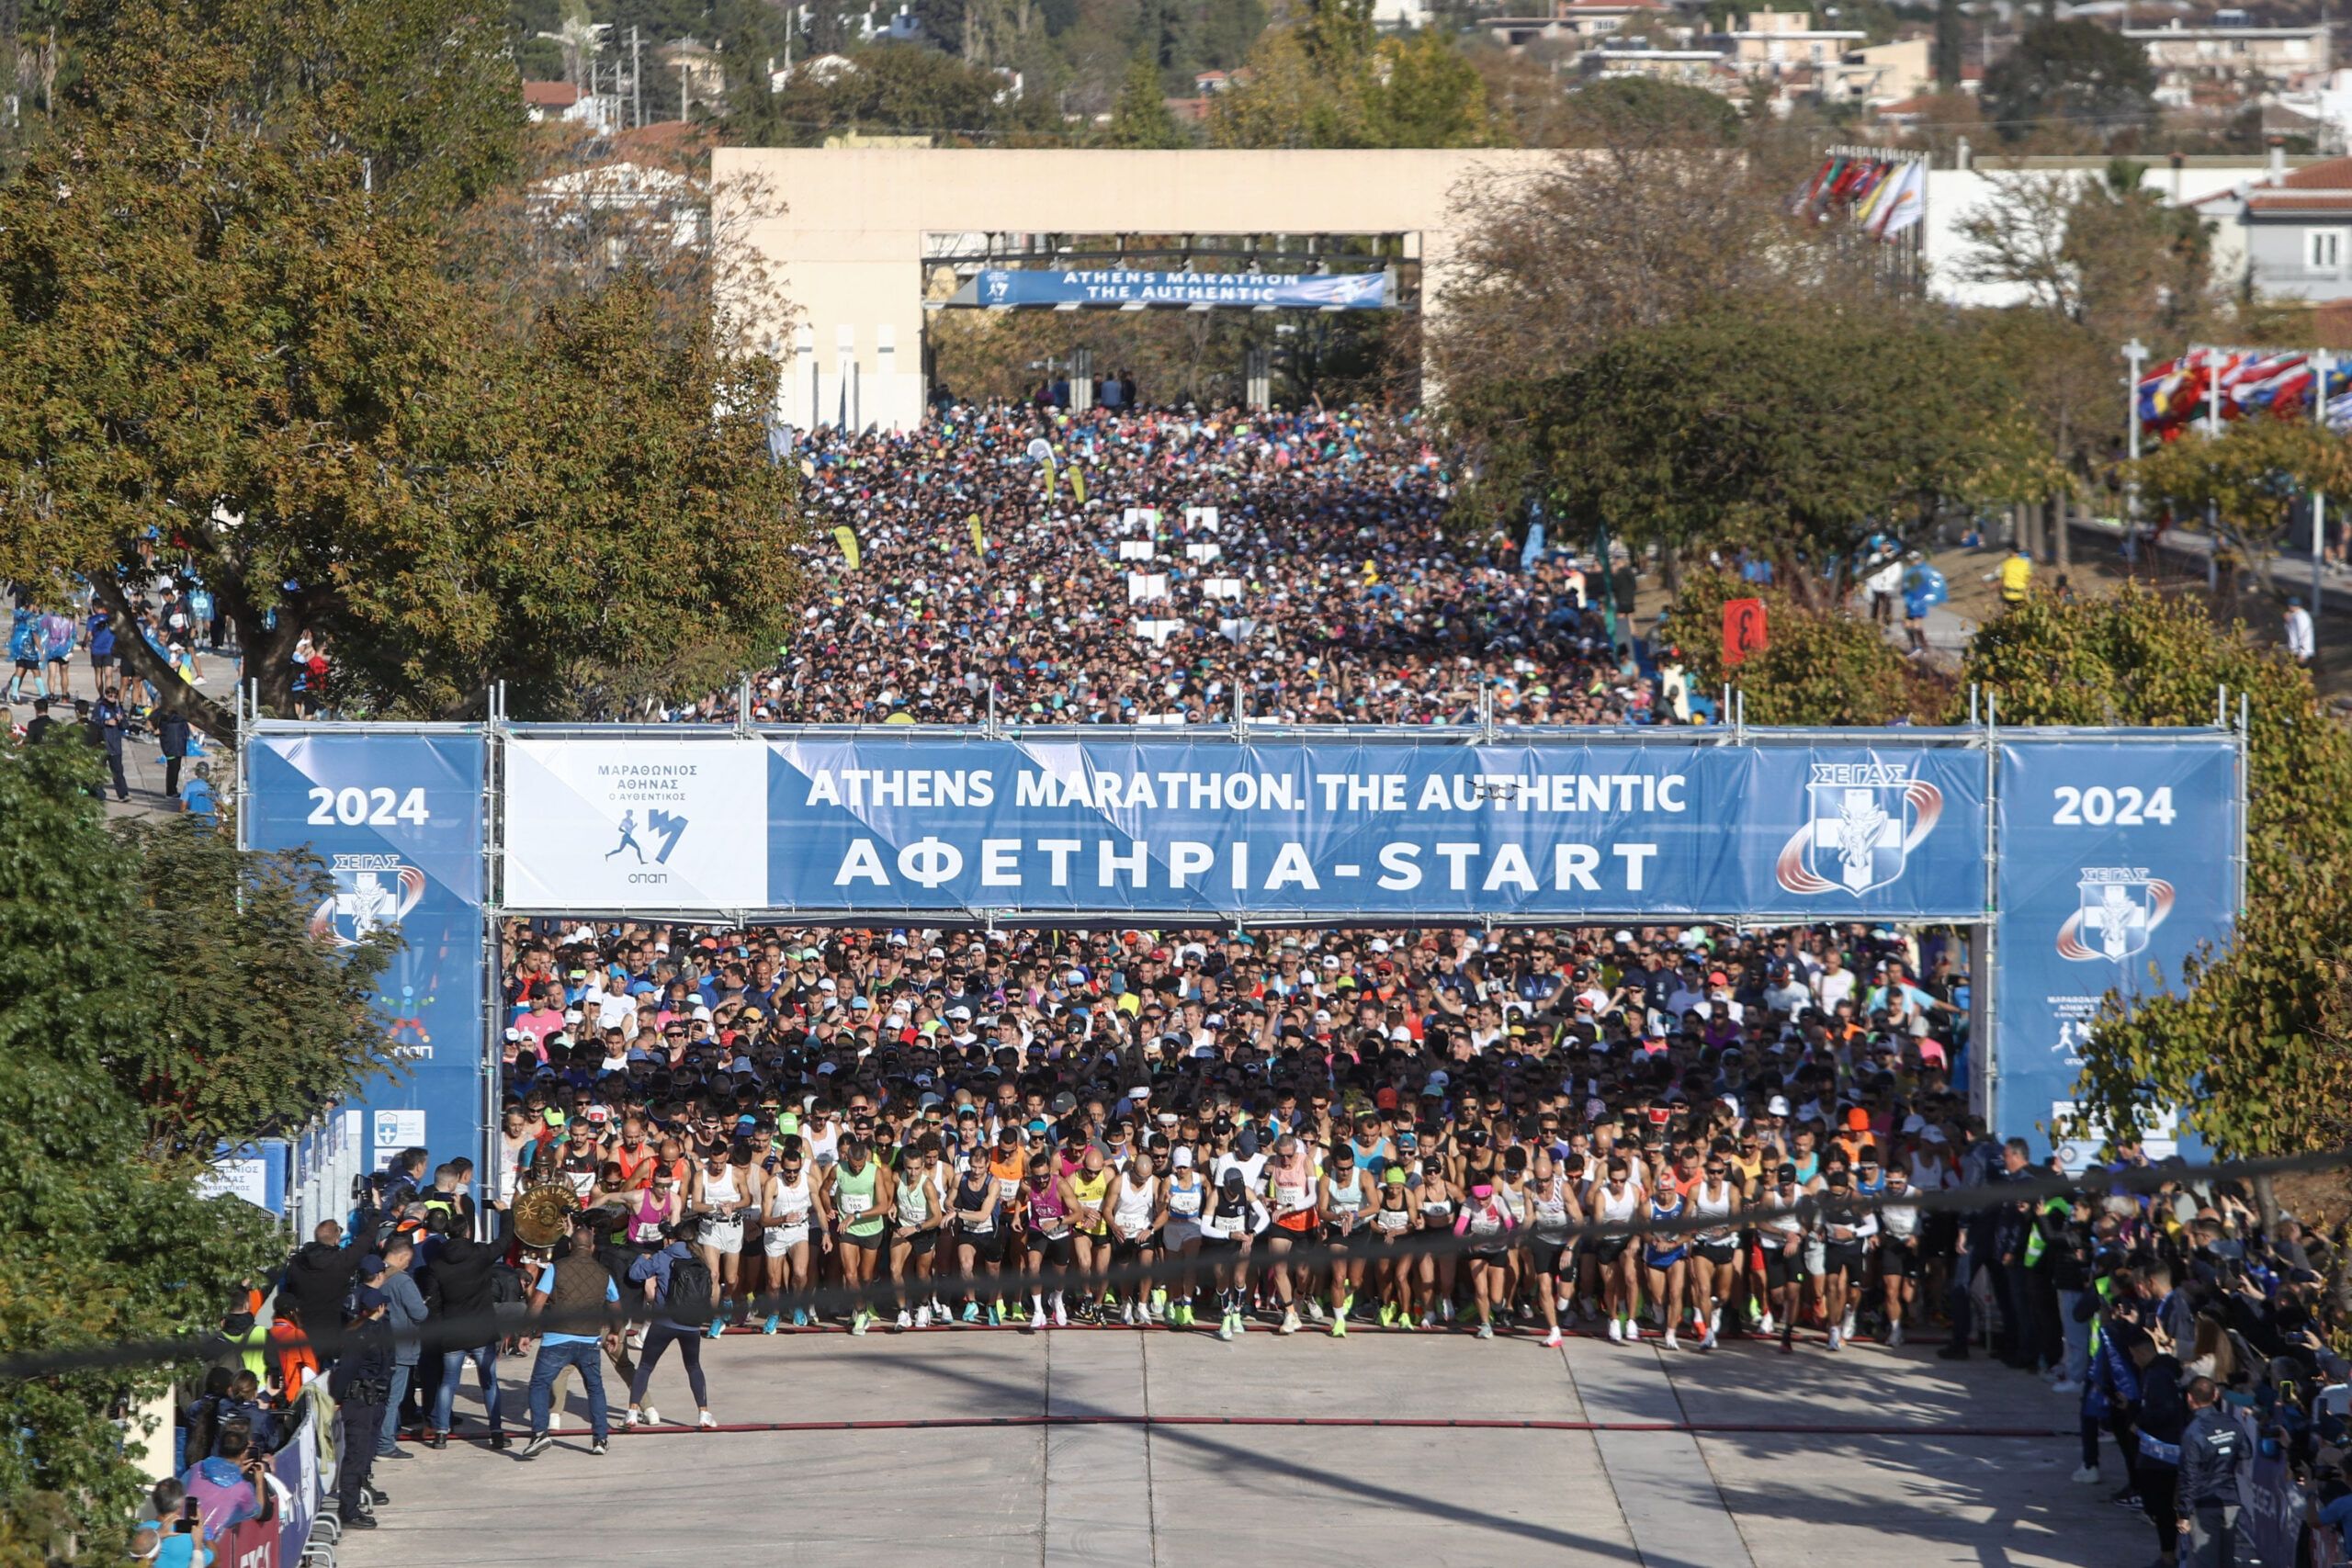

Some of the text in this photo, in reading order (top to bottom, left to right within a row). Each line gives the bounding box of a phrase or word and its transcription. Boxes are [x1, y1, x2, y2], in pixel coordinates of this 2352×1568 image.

[1063, 272, 1299, 287] ATHENS MARATHON
[1087, 286, 1276, 301] THE AUTHENTIC
[598, 765, 698, 776] ΜΑΡΑΘΩΝΙΟΣ
[1810, 763, 1907, 784] ΣΕΓΑΣ
[616, 780, 678, 789] ΑΘΗΝΑΣ
[805, 770, 1687, 812] ATHENS MARATHON. THE AUTHENTIC
[619, 793, 686, 801] ΑΥΘΕΝΤΙΚΟΣ
[306, 787, 430, 825] 2024
[2052, 785, 2177, 826] 2024
[332, 854, 401, 870] ΣΕΓΑΣ
[2080, 867, 2150, 882] ΣΕΓΑΣ
